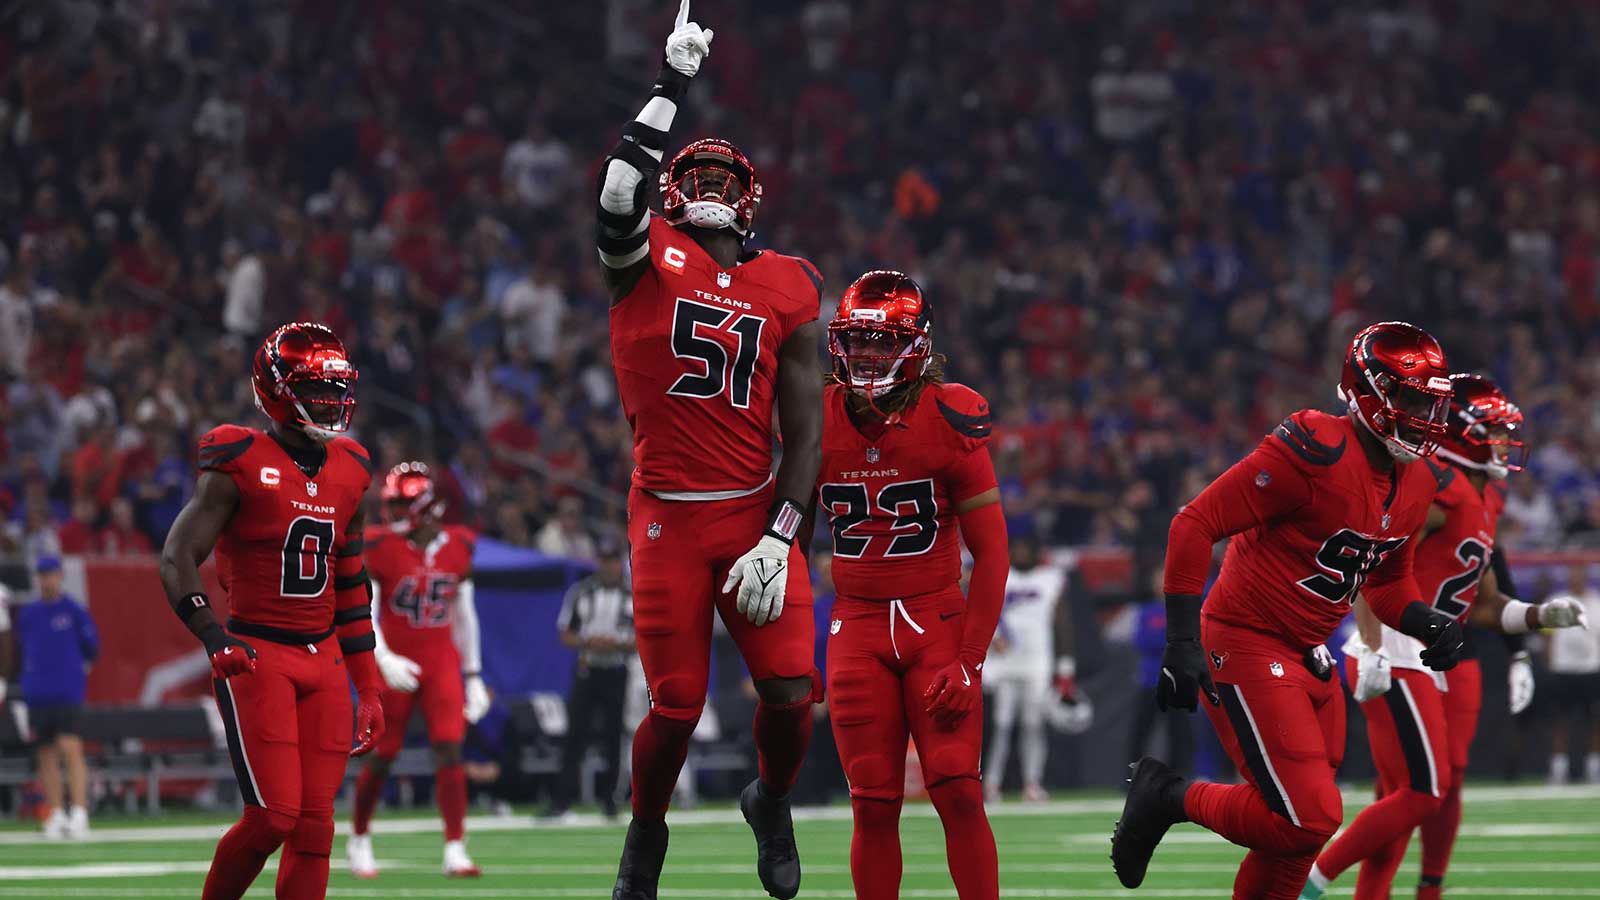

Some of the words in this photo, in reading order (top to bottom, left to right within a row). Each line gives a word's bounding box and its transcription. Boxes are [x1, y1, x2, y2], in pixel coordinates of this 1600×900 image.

[664, 246, 685, 268] C
[694, 289, 752, 310] TEXANS
[666, 297, 767, 409] 51
[260, 467, 280, 485] C
[840, 468, 899, 479] TEXANS
[291, 500, 336, 514] TEXANS
[820, 478, 938, 558] 23
[390, 572, 458, 628] 45
